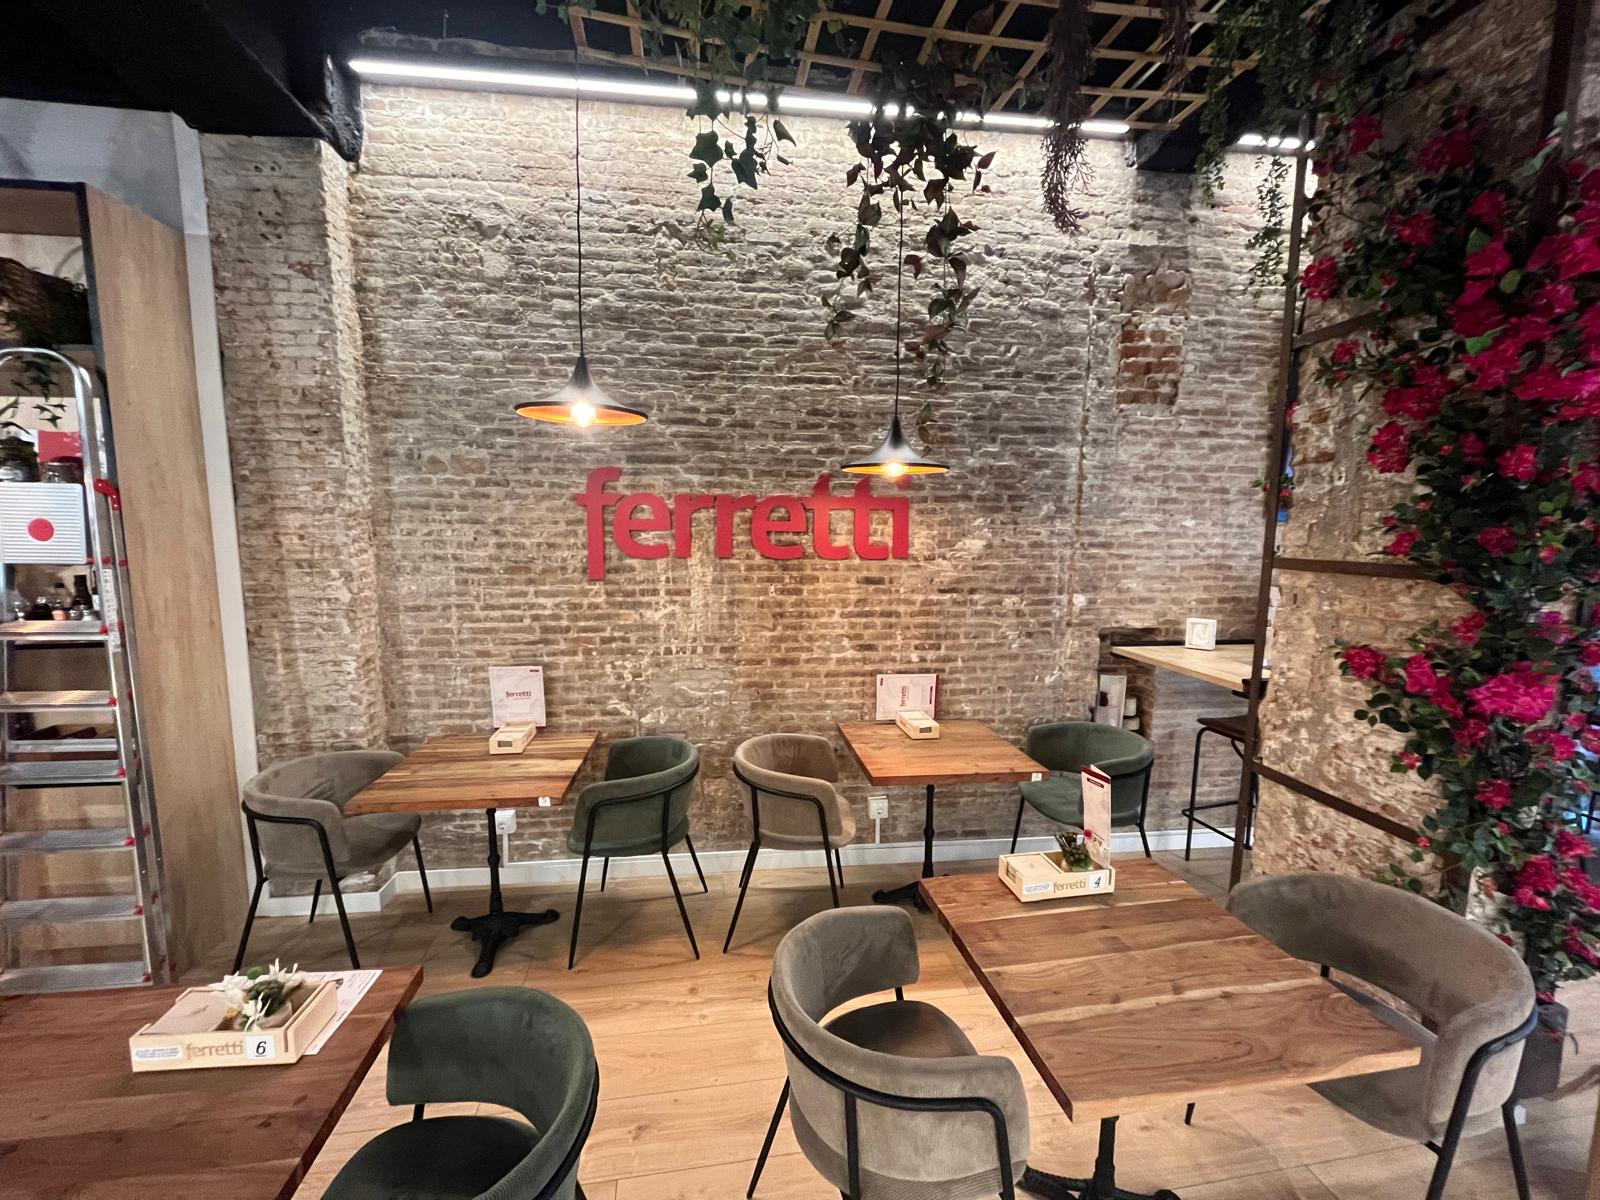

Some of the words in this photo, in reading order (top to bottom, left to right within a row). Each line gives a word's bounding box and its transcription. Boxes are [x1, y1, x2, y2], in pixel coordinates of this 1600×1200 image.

[575, 466, 912, 582] ferretti
[1053, 879, 1087, 894] ferretti
[1094, 876, 1101, 887] 4
[185, 1040, 244, 1060] ferretti
[255, 1041, 267, 1055] 6
